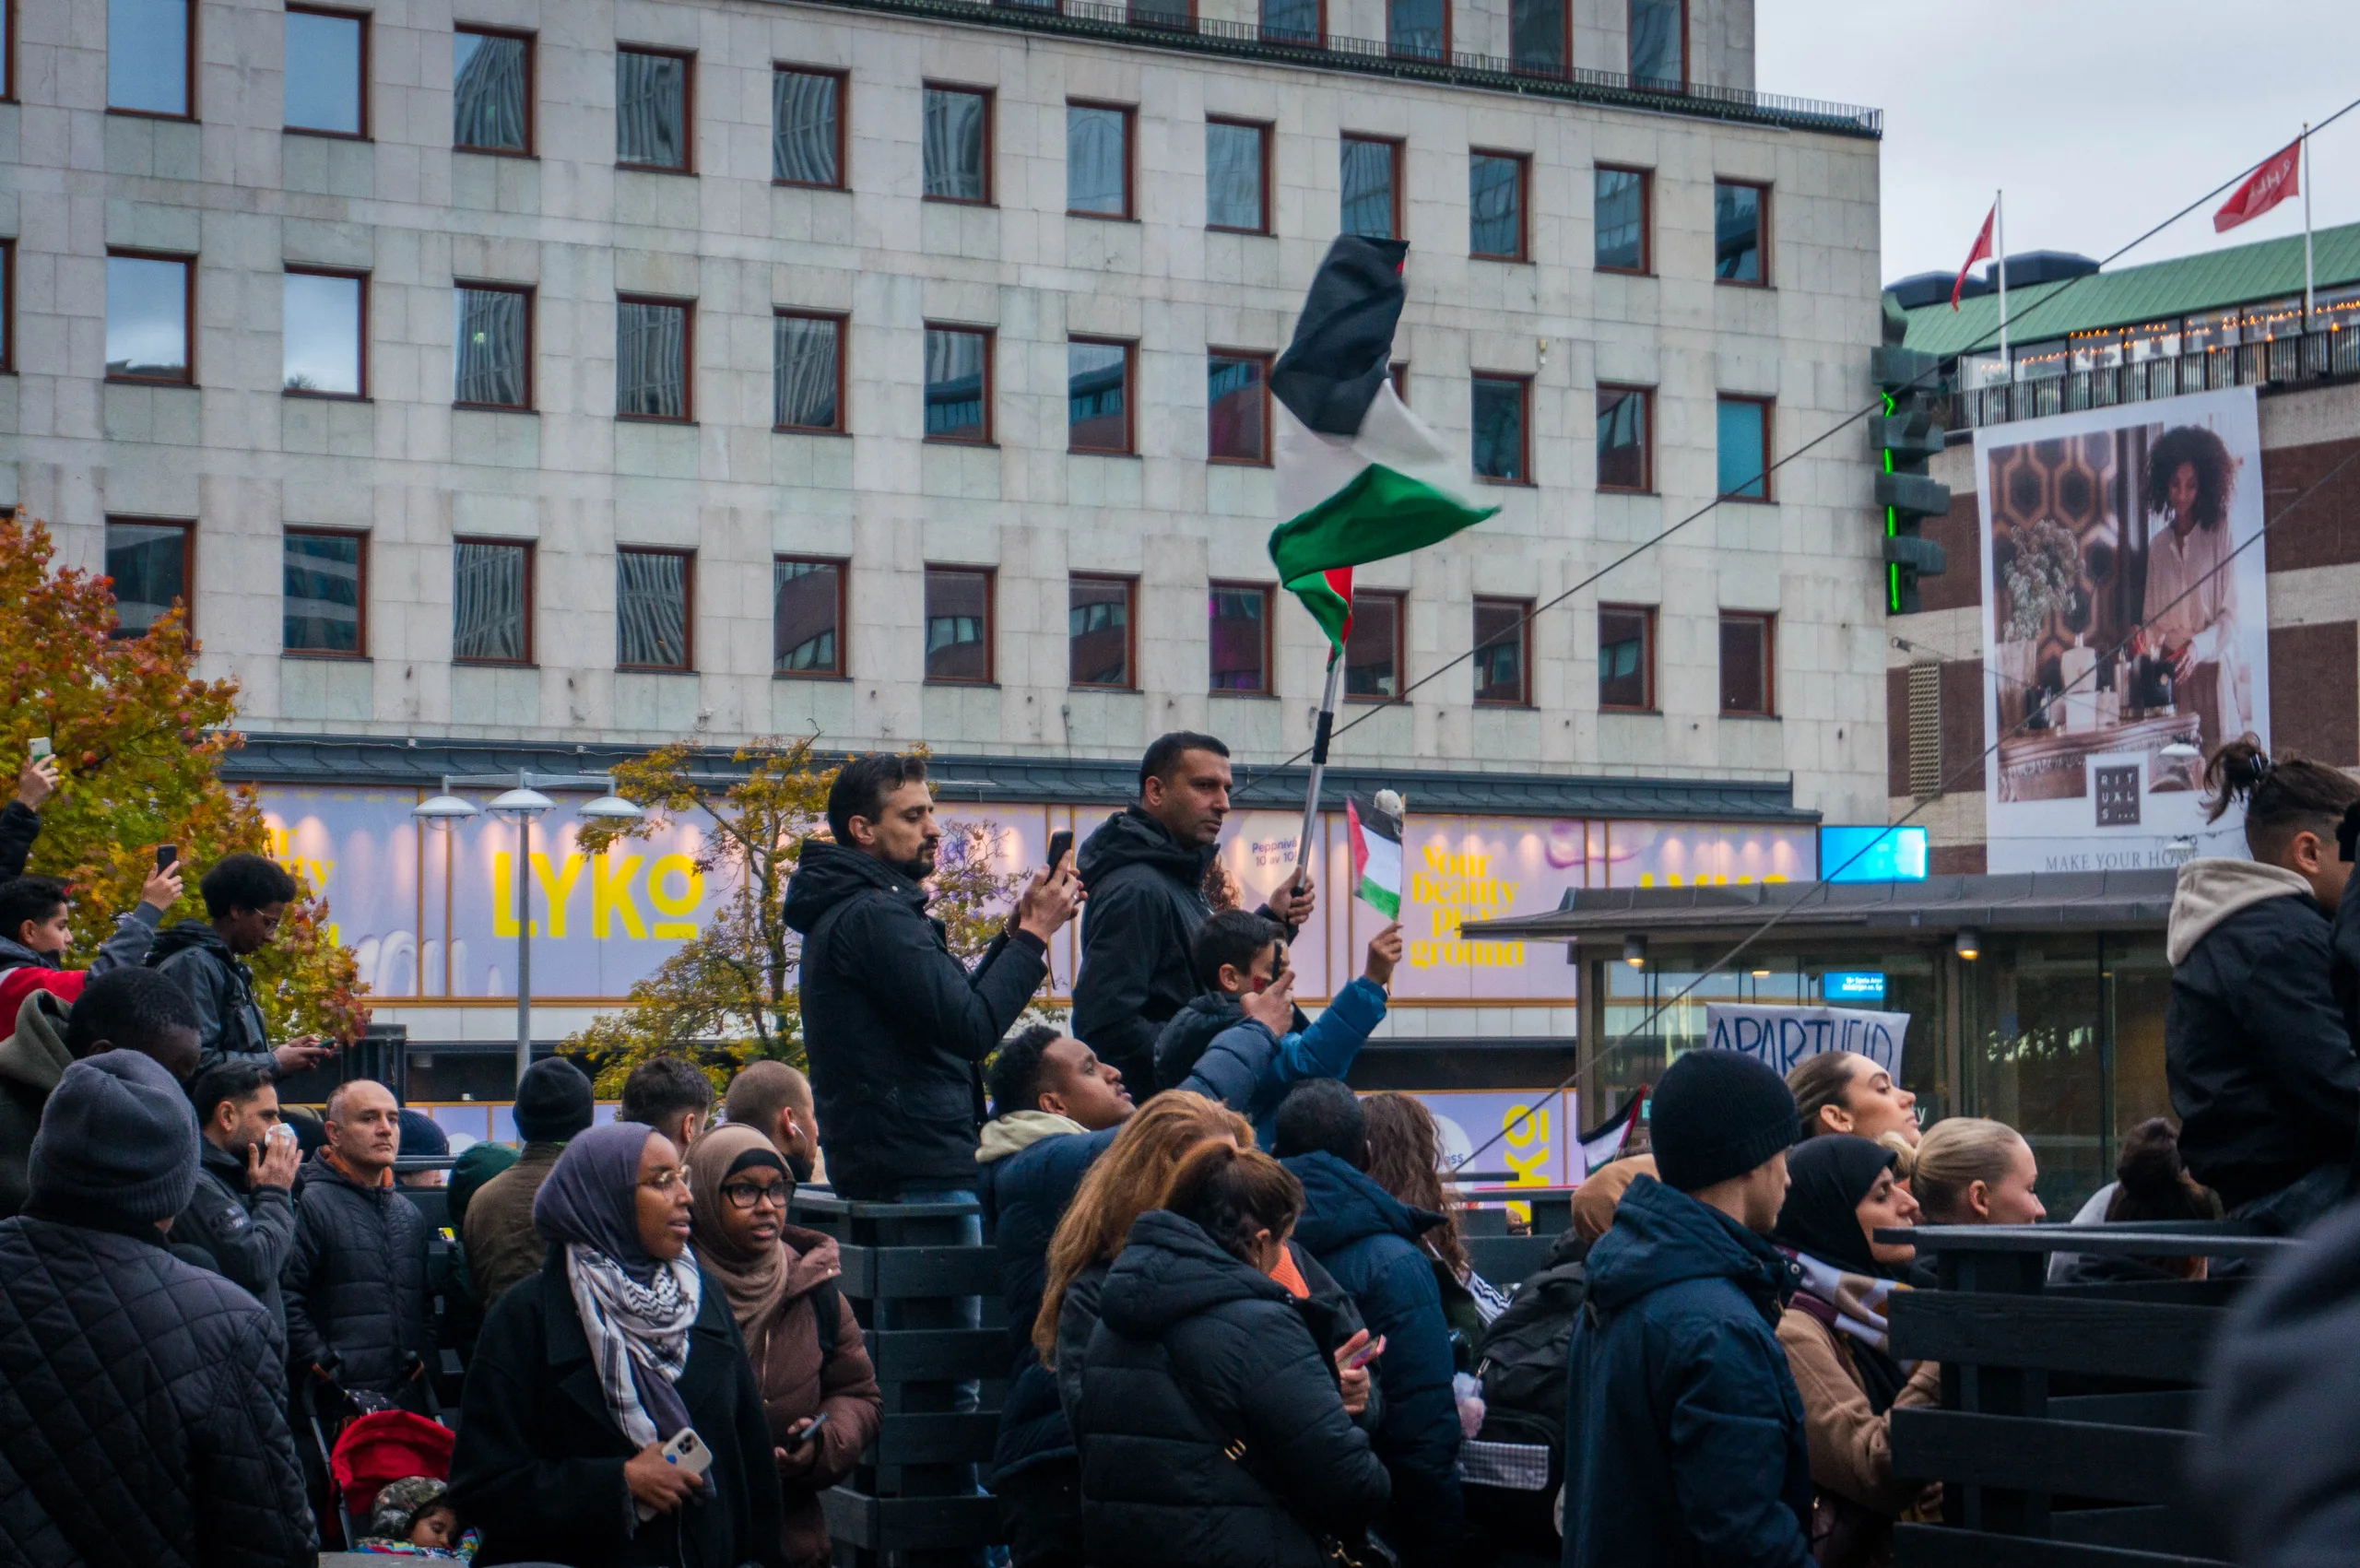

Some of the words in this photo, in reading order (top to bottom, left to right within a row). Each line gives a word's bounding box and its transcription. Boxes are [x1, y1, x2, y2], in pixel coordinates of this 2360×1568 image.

[1422, 844, 1493, 878] Your
[2045, 854, 2090, 872] MAKE
[2095, 852, 2142, 870] YOUR
[494, 852, 703, 938] LYKO
[1412, 871, 1519, 913] beauty
